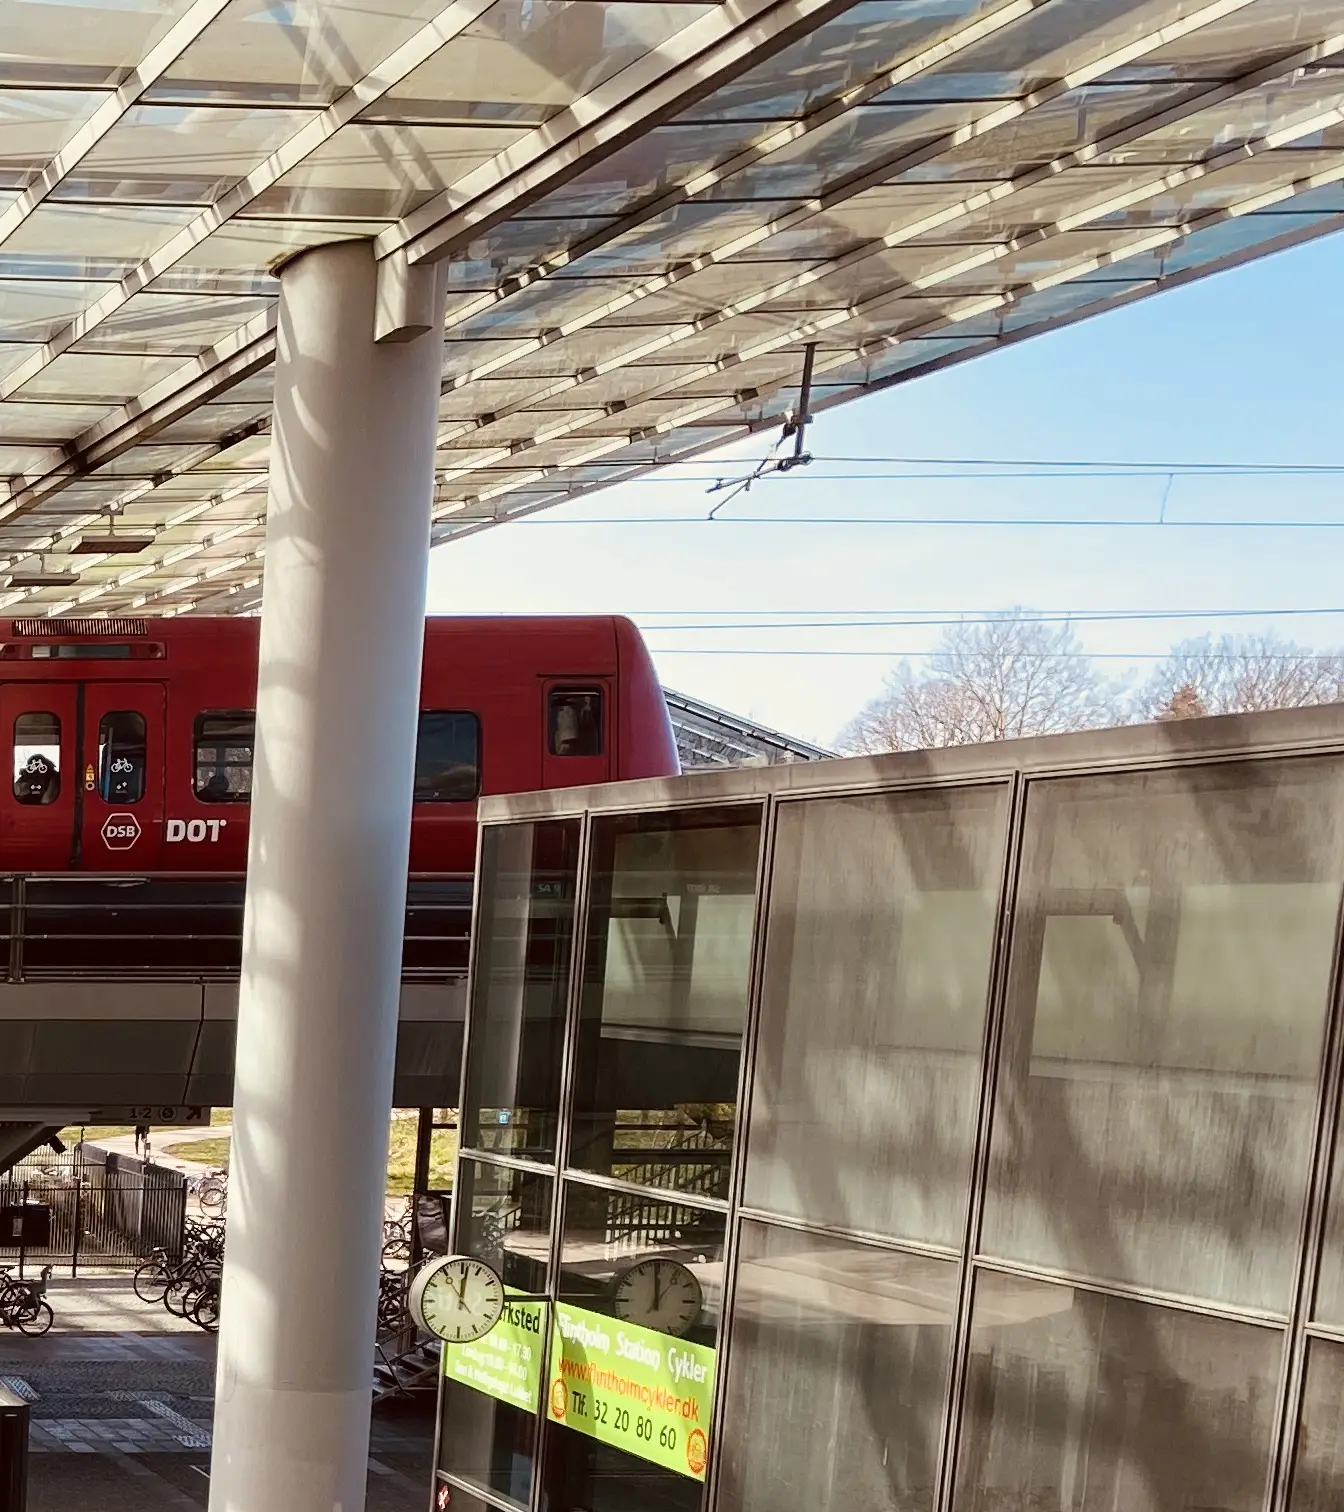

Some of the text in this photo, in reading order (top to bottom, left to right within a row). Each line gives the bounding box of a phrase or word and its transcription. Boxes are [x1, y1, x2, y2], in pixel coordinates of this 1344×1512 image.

[106, 825, 136, 838] DSB
[166, 819, 227, 842] DOT
[668, 1346, 708, 1384] Cykler
[593, 1398, 608, 1425] 32
[614, 1407, 630, 1433] 20
[636, 1415, 653, 1442] 80
[659, 1424, 677, 1451] 60
